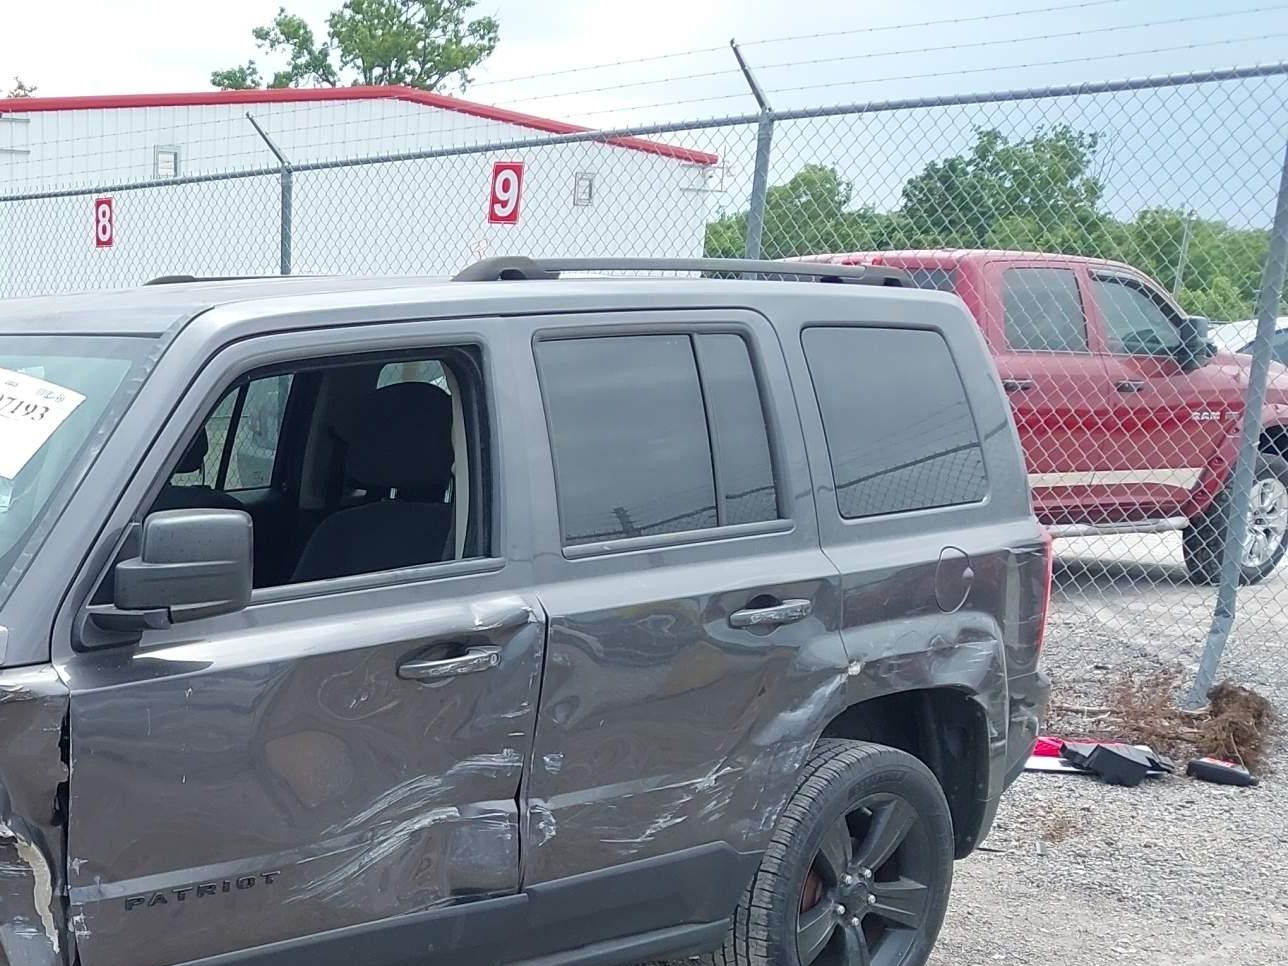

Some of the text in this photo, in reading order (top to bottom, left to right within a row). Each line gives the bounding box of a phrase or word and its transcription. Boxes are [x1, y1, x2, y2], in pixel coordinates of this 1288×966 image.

[493, 168, 519, 217] 9
[97, 203, 111, 242] 8
[124, 870, 281, 912] PATRIOT
